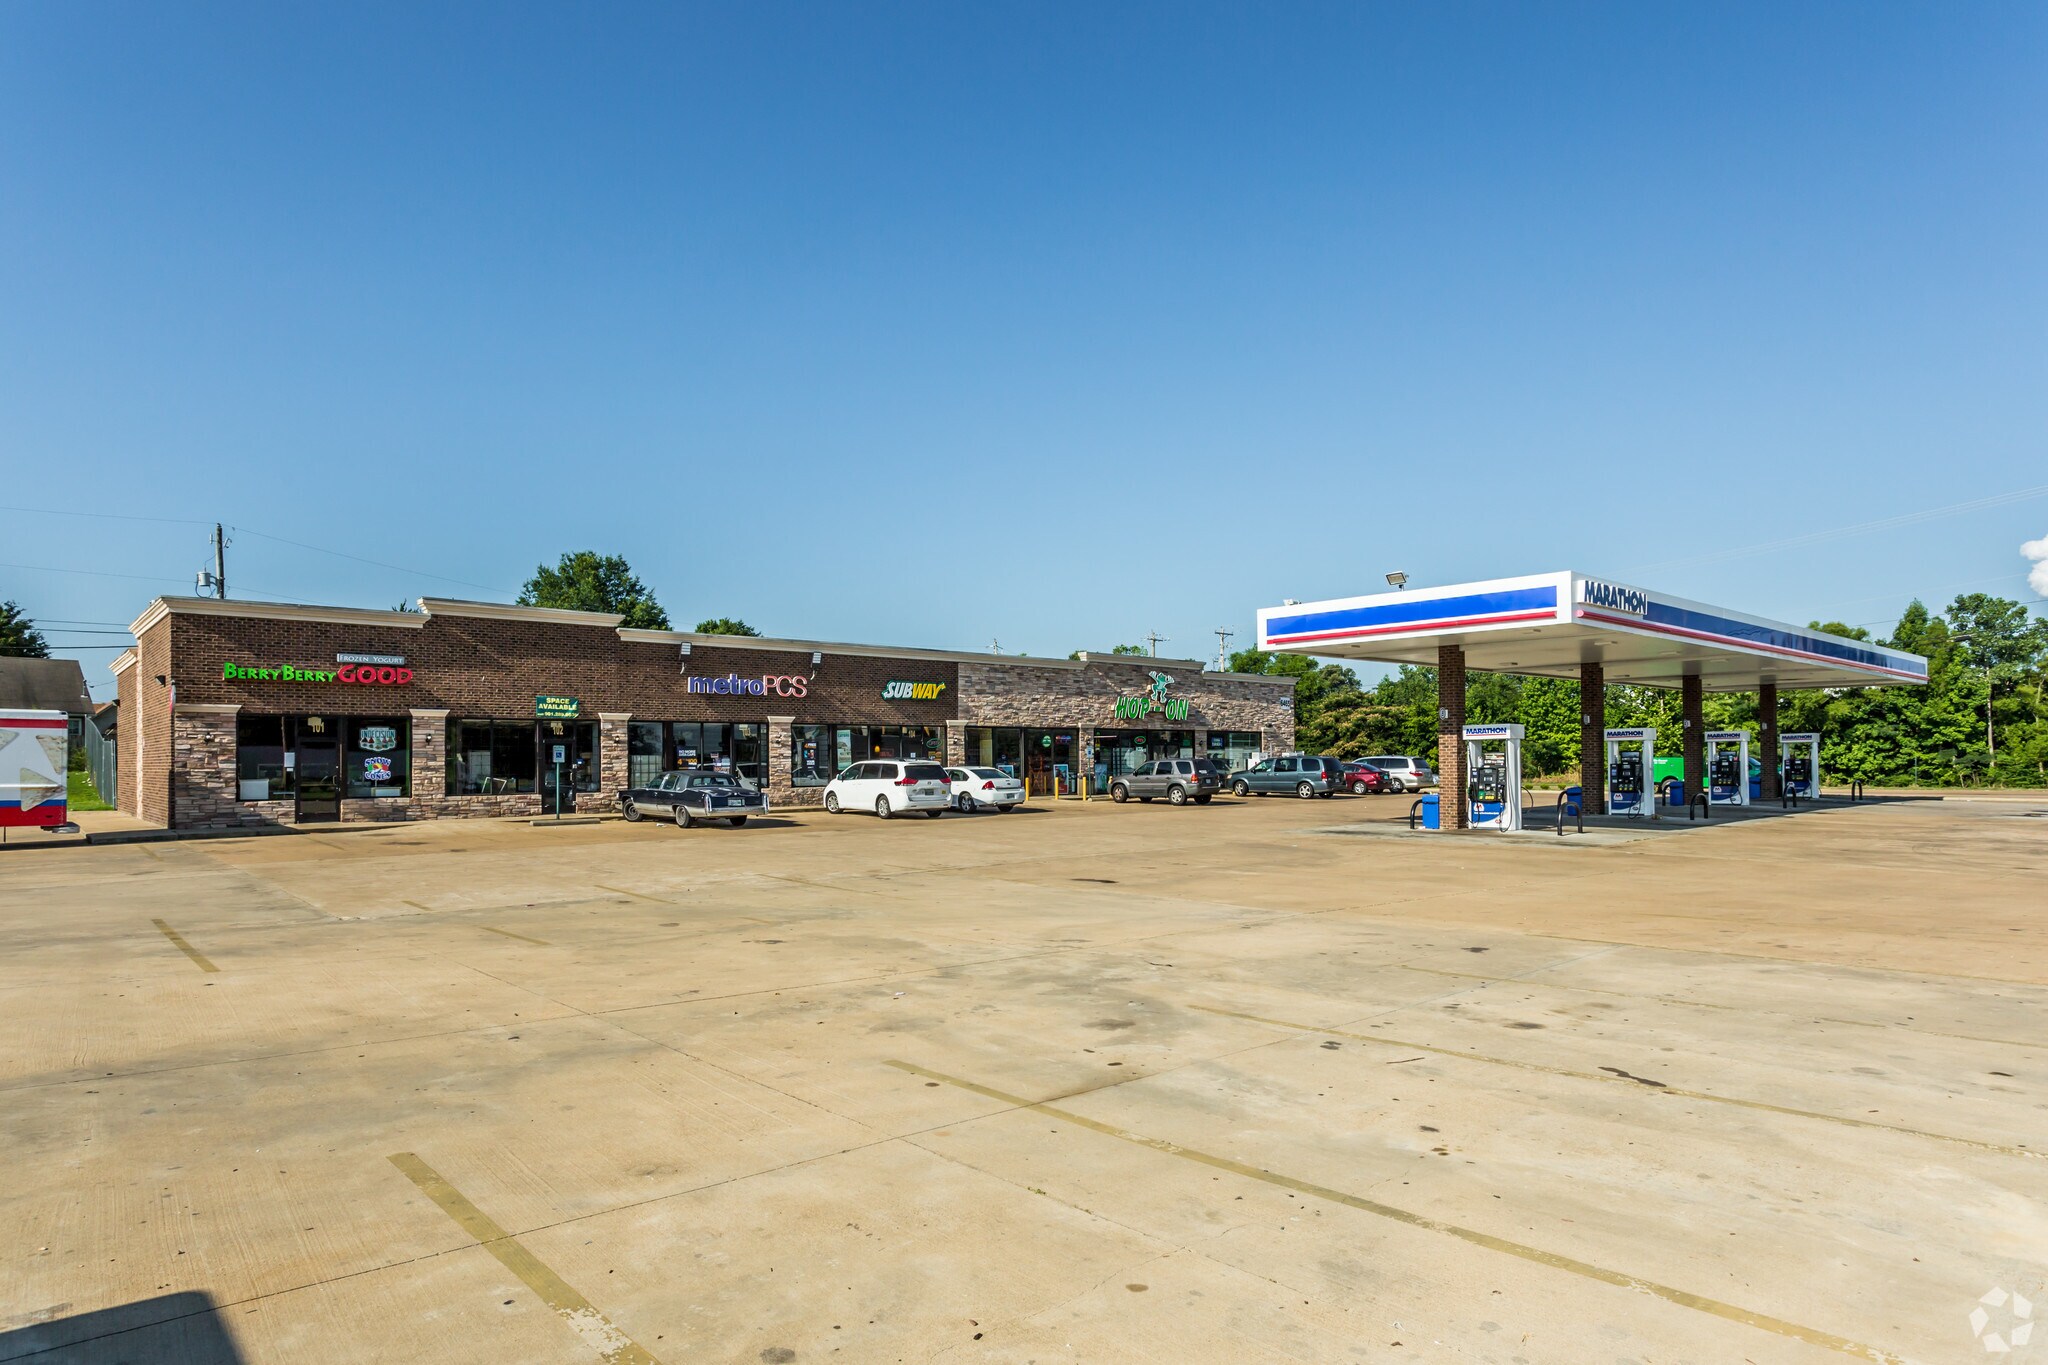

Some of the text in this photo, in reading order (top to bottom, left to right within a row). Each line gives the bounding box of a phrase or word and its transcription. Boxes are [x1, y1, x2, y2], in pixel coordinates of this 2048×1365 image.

[1584, 581, 1647, 614] MARATHON
[340, 654, 403, 664] FROZEN YOGURT
[337, 664, 413, 685] GOOD
[688, 673, 808, 698] metroPCS
[882, 682, 946, 699] SUBWAY
[538, 703, 577, 711] AVAILABLE
[361, 729, 396, 739] INDECISION
[1466, 727, 1507, 735] MARATHON
[364, 757, 391, 767] SNOW
[364, 770, 391, 781] CONES
